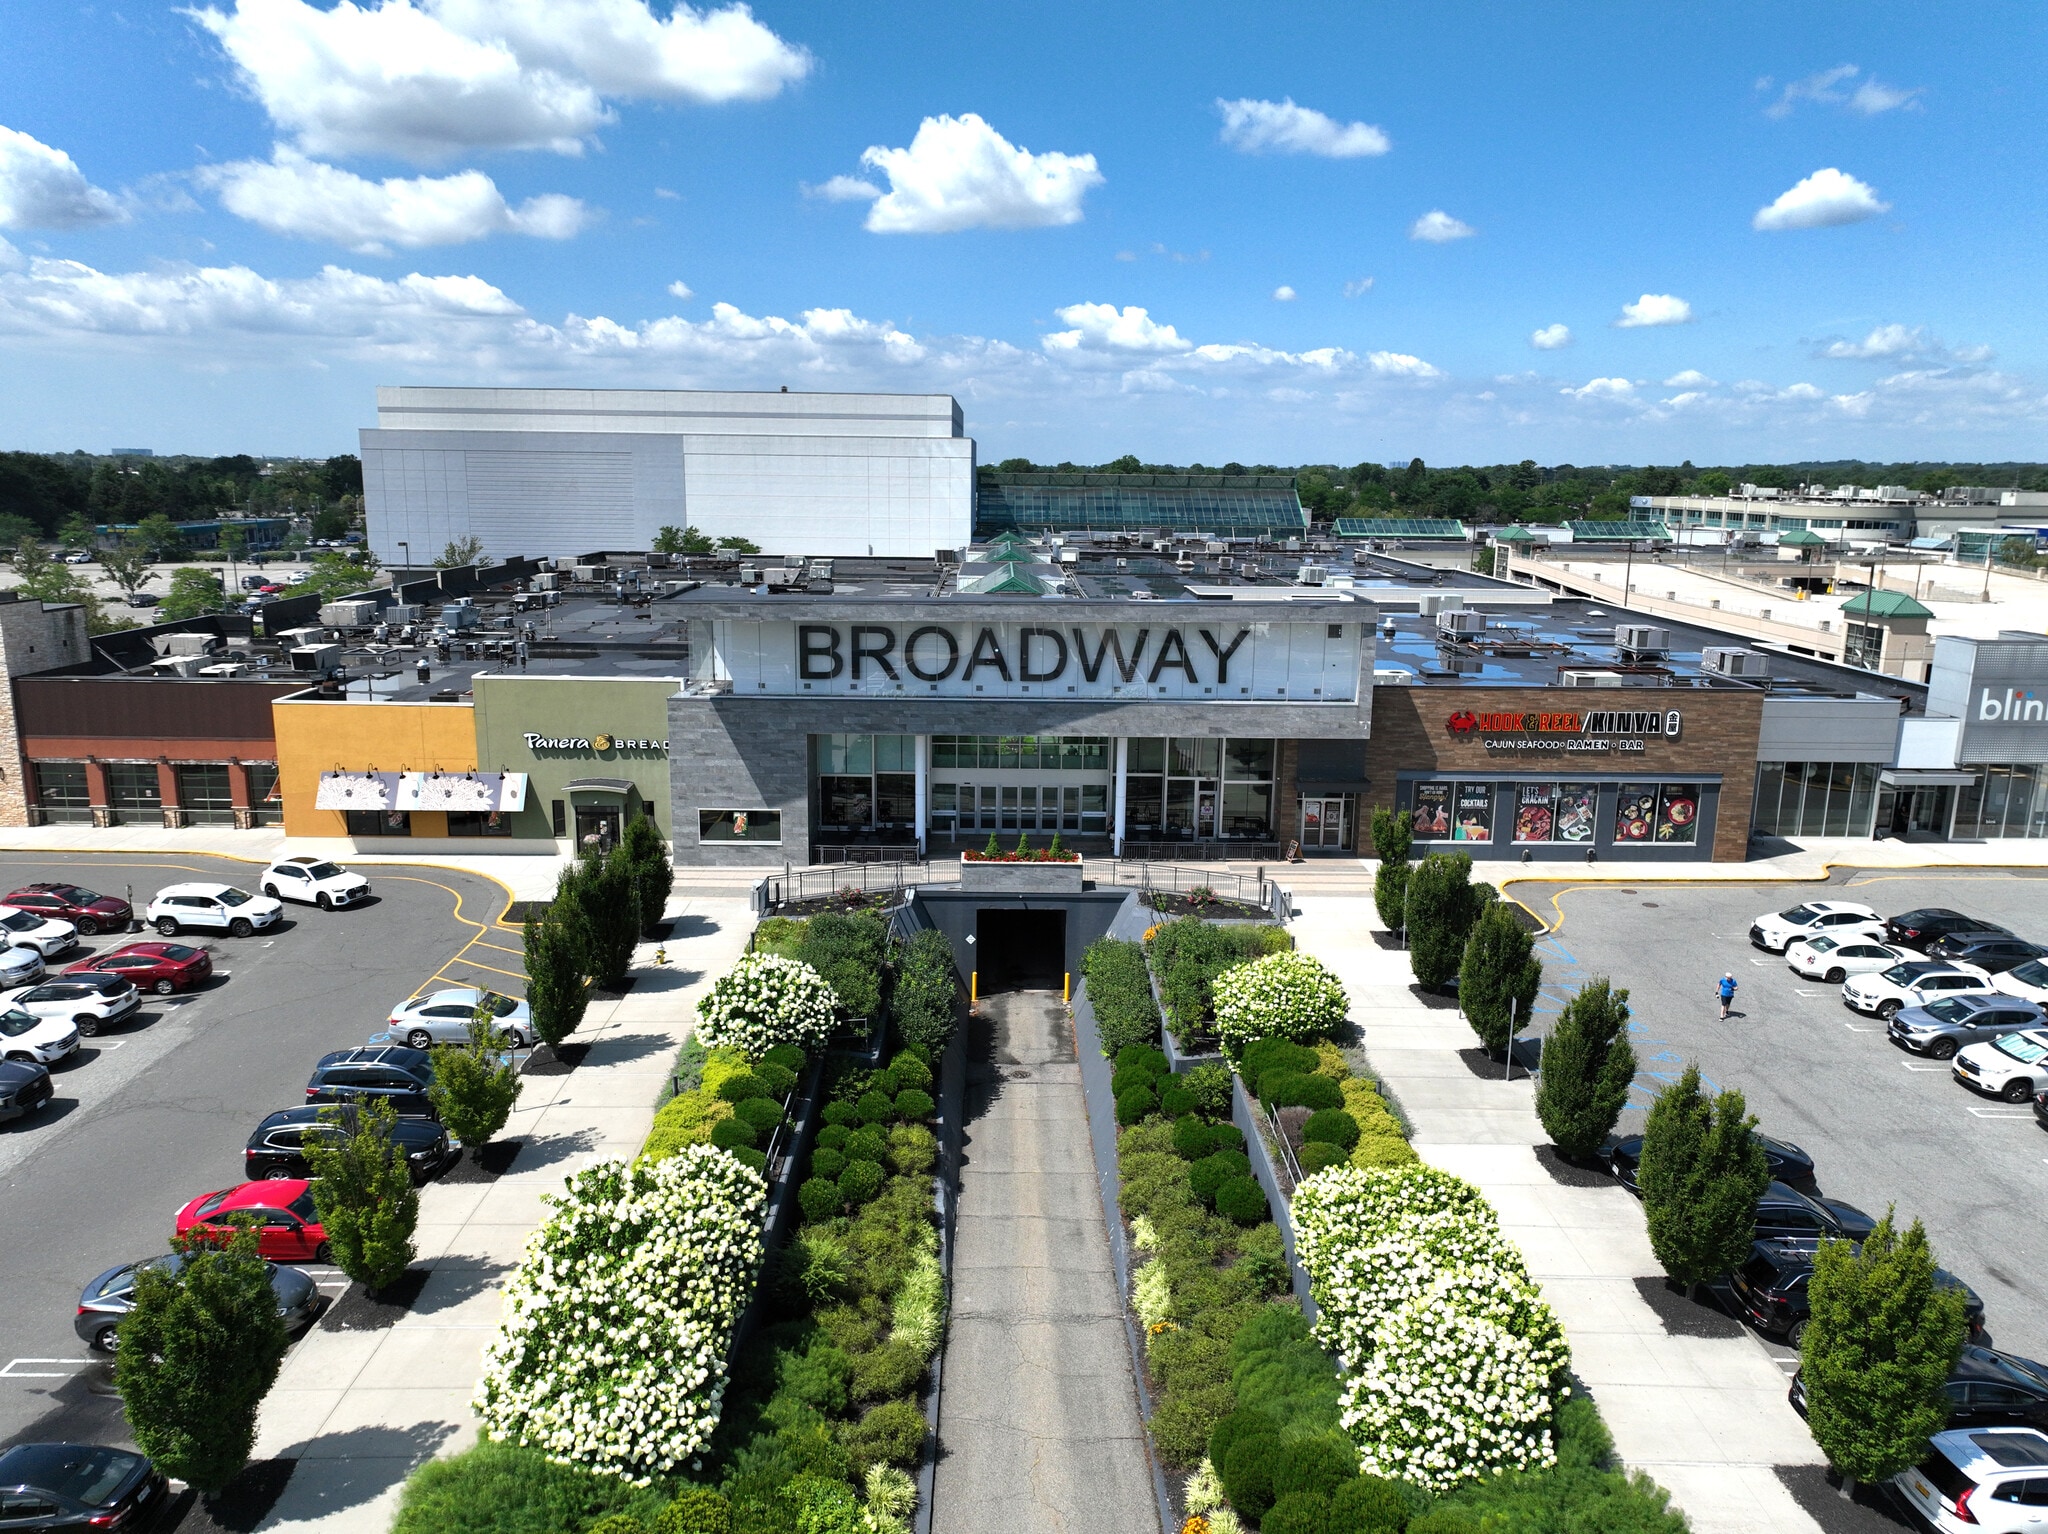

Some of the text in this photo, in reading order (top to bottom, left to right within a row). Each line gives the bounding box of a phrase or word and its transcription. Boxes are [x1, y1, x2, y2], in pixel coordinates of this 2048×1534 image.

[798, 625, 1251, 684] BROADWAY
[1979, 687, 2048, 721] blin
[1479, 712, 1526, 732] HOOK
[523, 732, 590, 750] Panera
[1484, 739, 1644, 751] CAJUN SEAFOOD RAMEN BAR
[1465, 786, 1487, 794] TRY OUR
[1460, 799, 1489, 807] COCKTAILS
